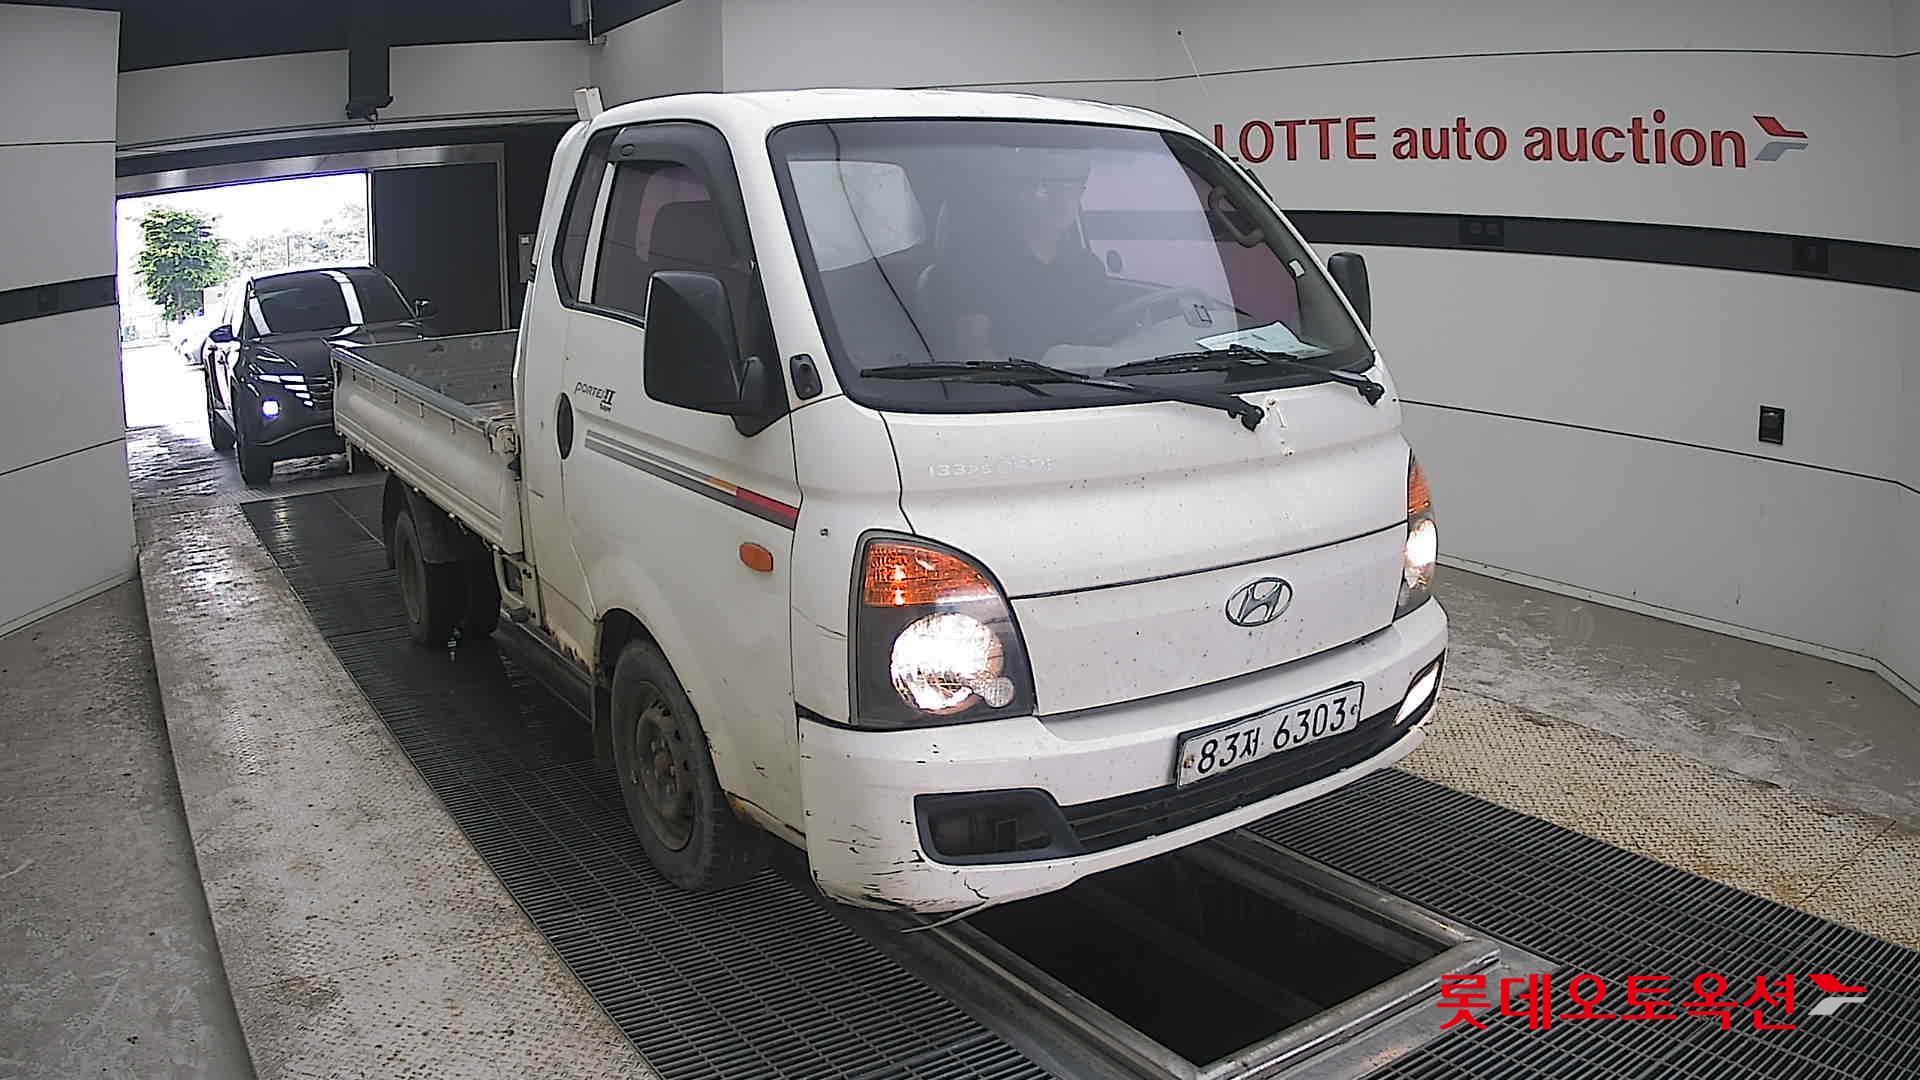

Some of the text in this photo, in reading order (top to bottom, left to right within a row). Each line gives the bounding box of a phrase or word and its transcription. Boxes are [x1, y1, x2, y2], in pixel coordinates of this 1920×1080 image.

[1213, 108, 1747, 168] LOTTE auto auction
[1197, 696, 1348, 774] 83저 6303
